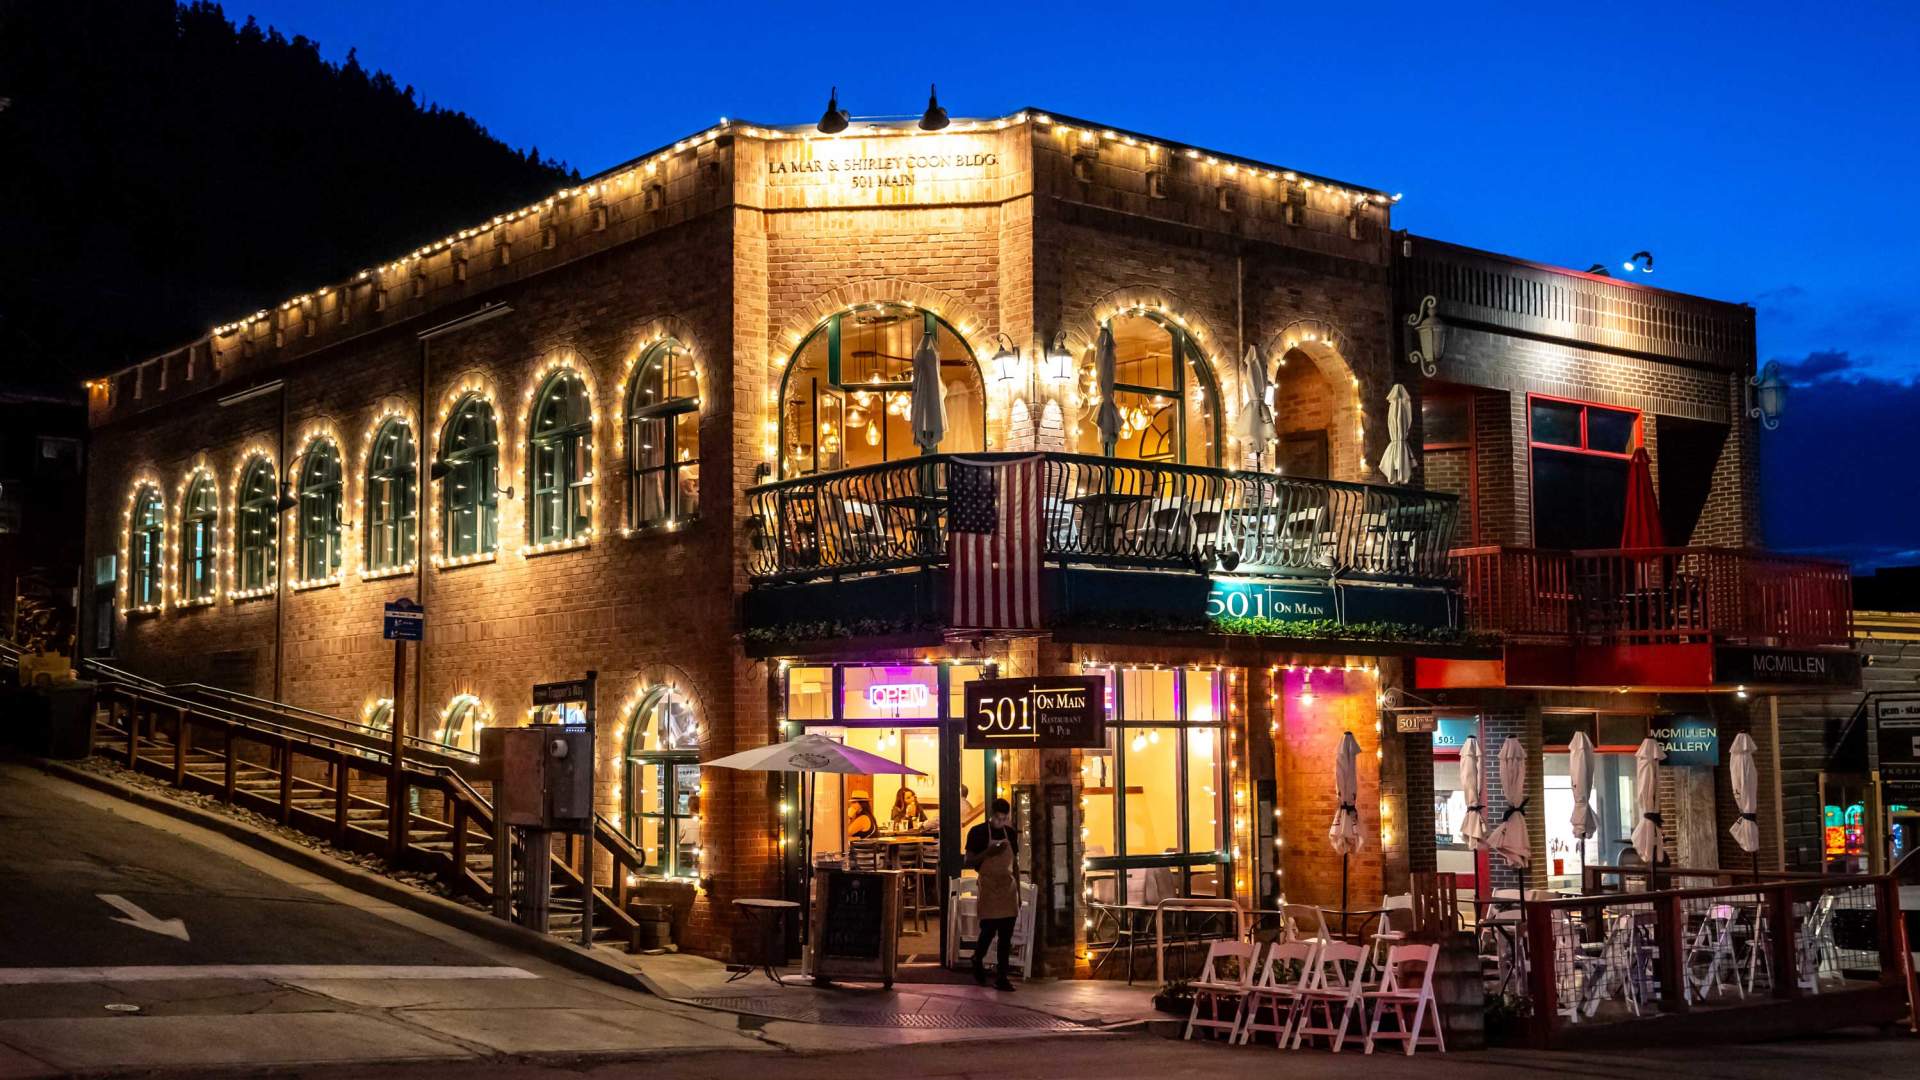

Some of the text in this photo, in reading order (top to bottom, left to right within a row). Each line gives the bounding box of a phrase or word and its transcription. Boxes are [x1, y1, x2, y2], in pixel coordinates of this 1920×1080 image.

[769, 153, 1000, 174] LA MAR & SHIRLEY COON BLDG.
[851, 174, 915, 189] 501 MAIN
[1204, 590, 1265, 618] 501
[1753, 654, 1825, 673] MCMILLEN
[873, 687, 926, 705] OPEN
[977, 696, 1032, 731] 501
[1400, 718, 1417, 728] 501
[1438, 735, 1454, 744] 505
[1650, 727, 1717, 738] MCMILLEN
[1657, 741, 1711, 752] GALLERY
